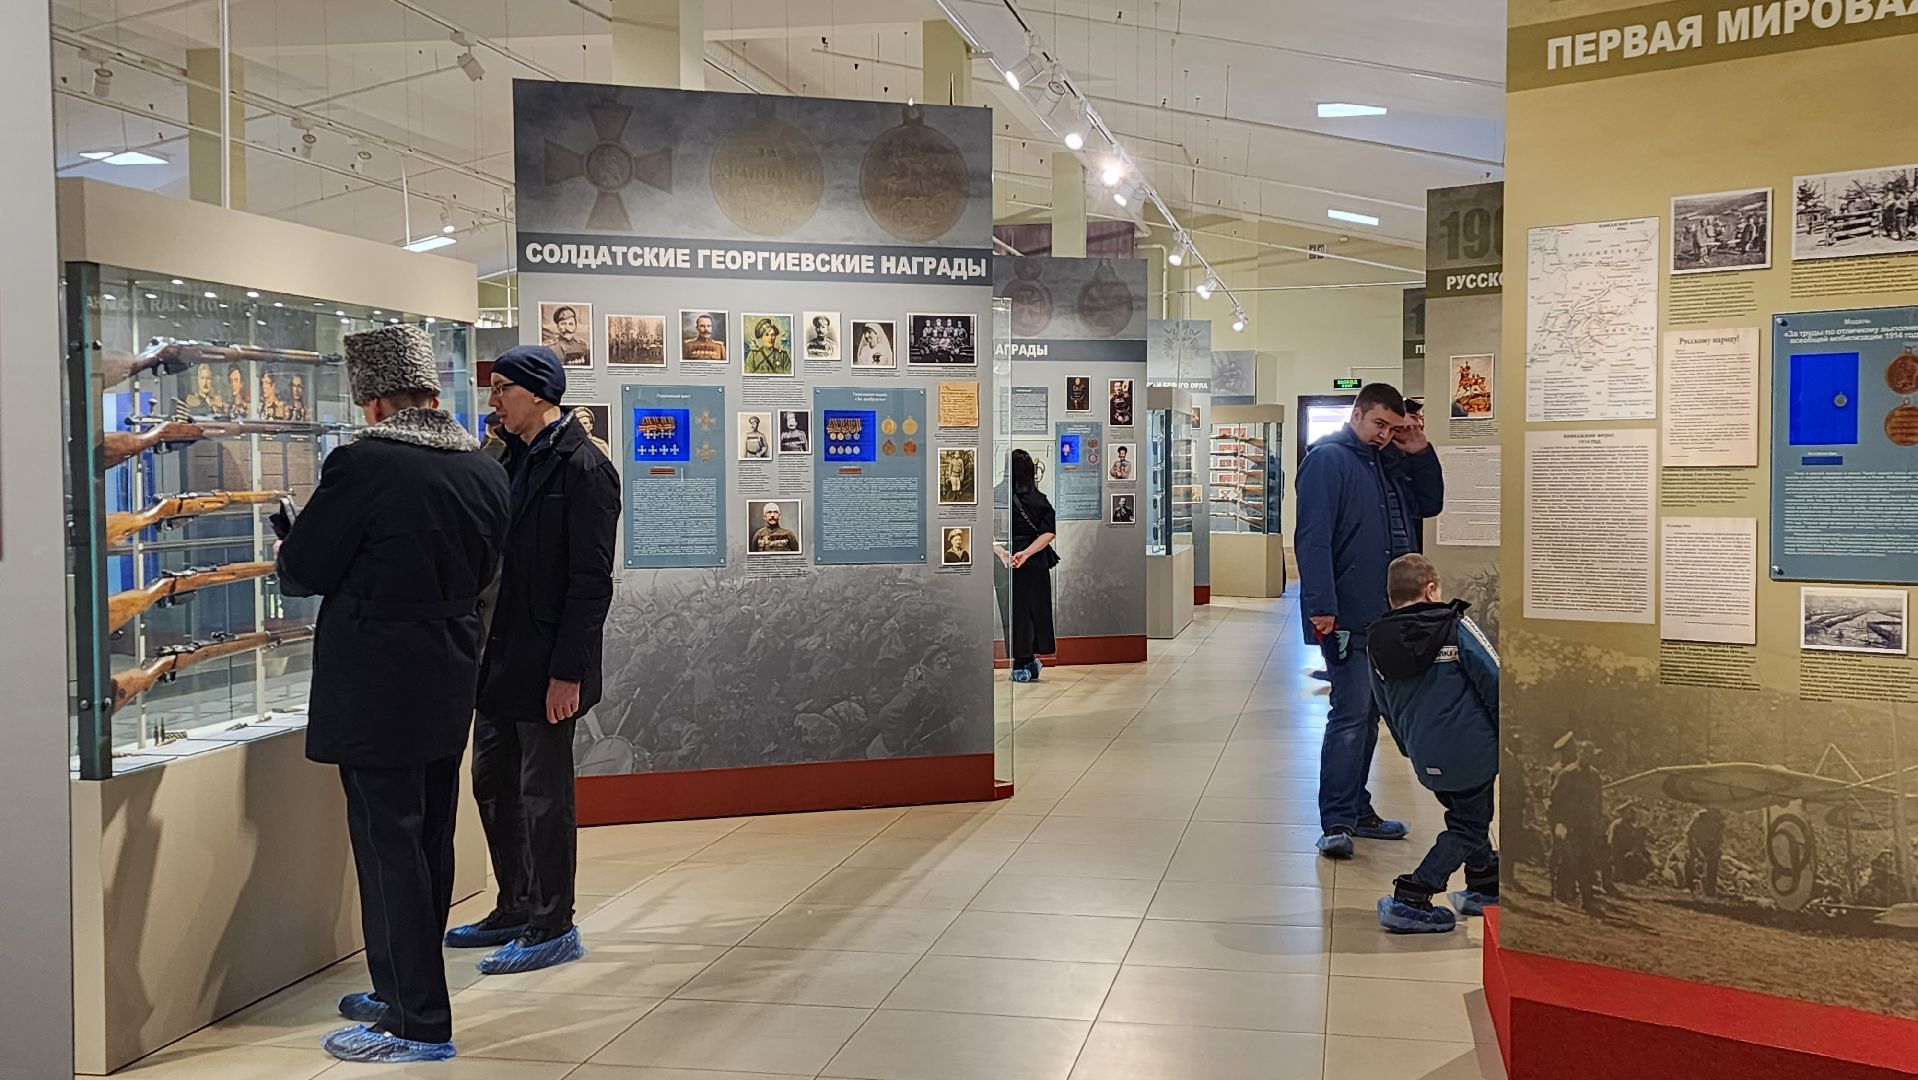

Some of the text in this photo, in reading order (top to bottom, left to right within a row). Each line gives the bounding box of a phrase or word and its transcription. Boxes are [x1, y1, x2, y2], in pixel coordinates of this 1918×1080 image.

[1547, 14, 1702, 70] ПЕРВАЯ
[525, 242, 986, 280] СОЛДАТСКИЕ ГЕОРГИЕВСКИЕ НАГРАДЫ
[1679, 333, 1740, 347] Русскому народу!
[993, 343, 1048, 358] АГРАДЫ
[1415, 344, 1425, 354] П
